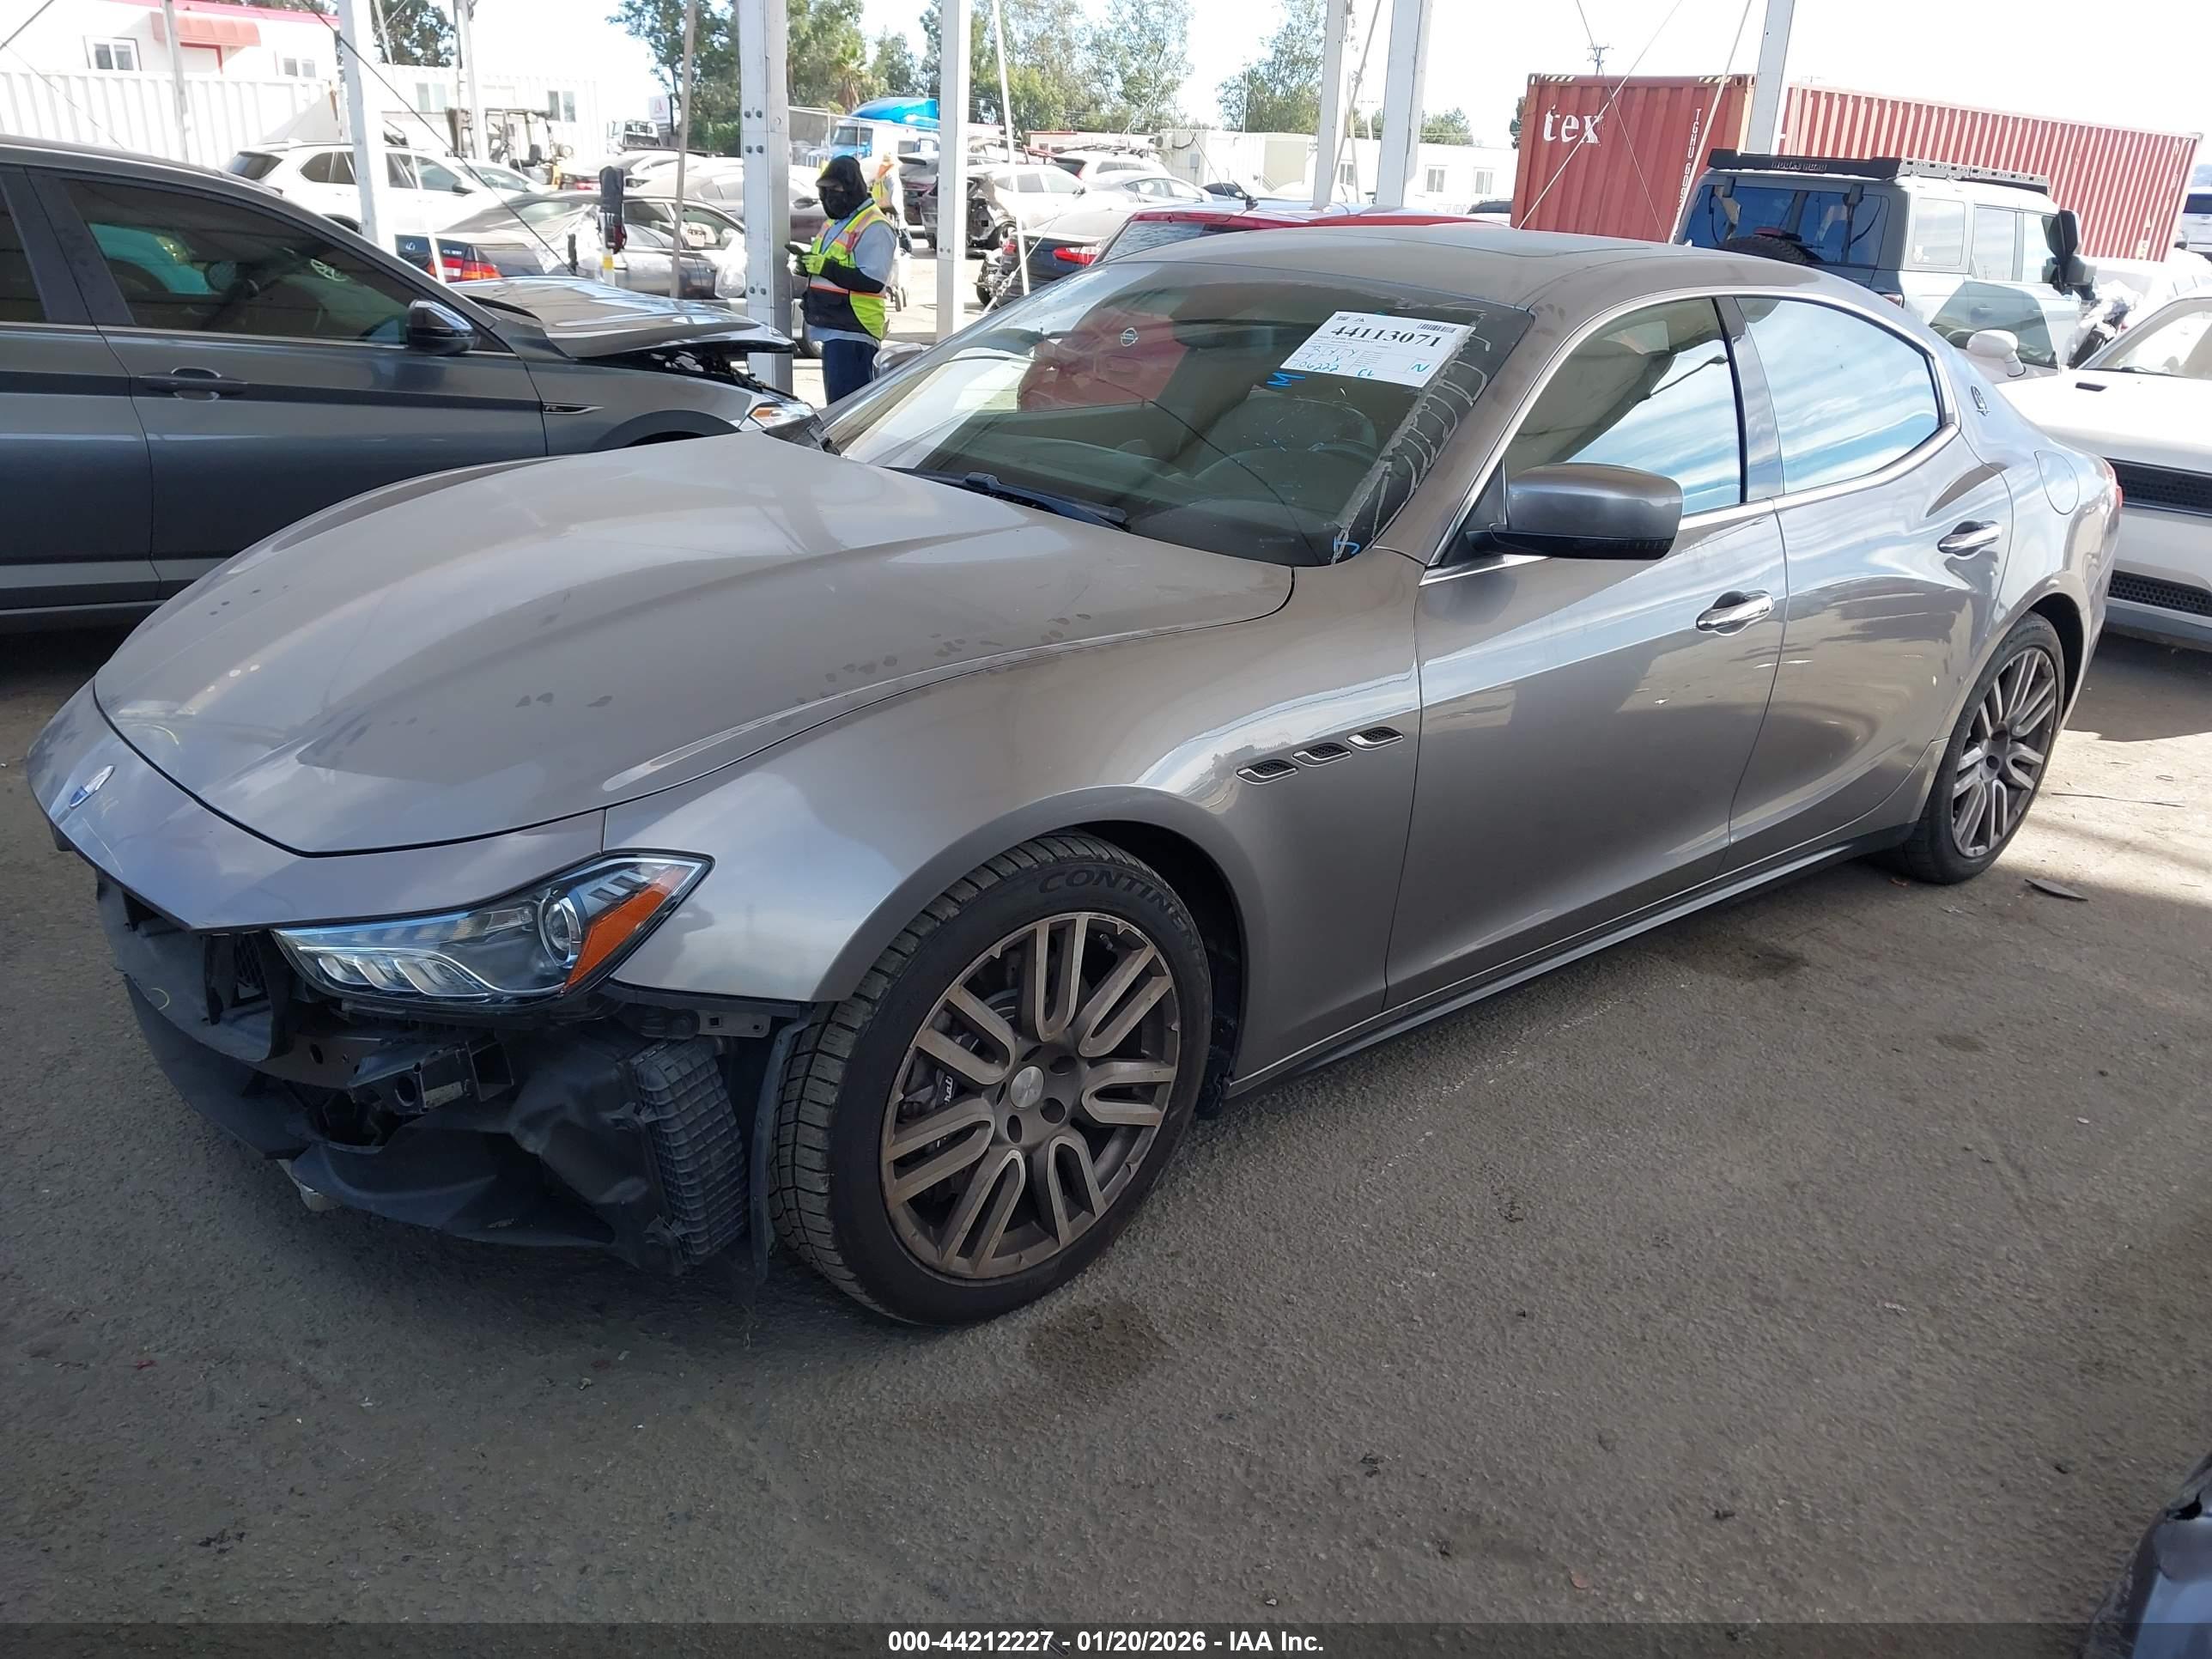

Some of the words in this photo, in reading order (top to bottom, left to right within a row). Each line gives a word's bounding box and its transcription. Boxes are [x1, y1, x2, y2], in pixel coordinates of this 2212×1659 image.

[1543, 103, 1604, 143] tex
[1687, 107, 1702, 159] TGHU
[1331, 325, 1442, 347] 44113071
